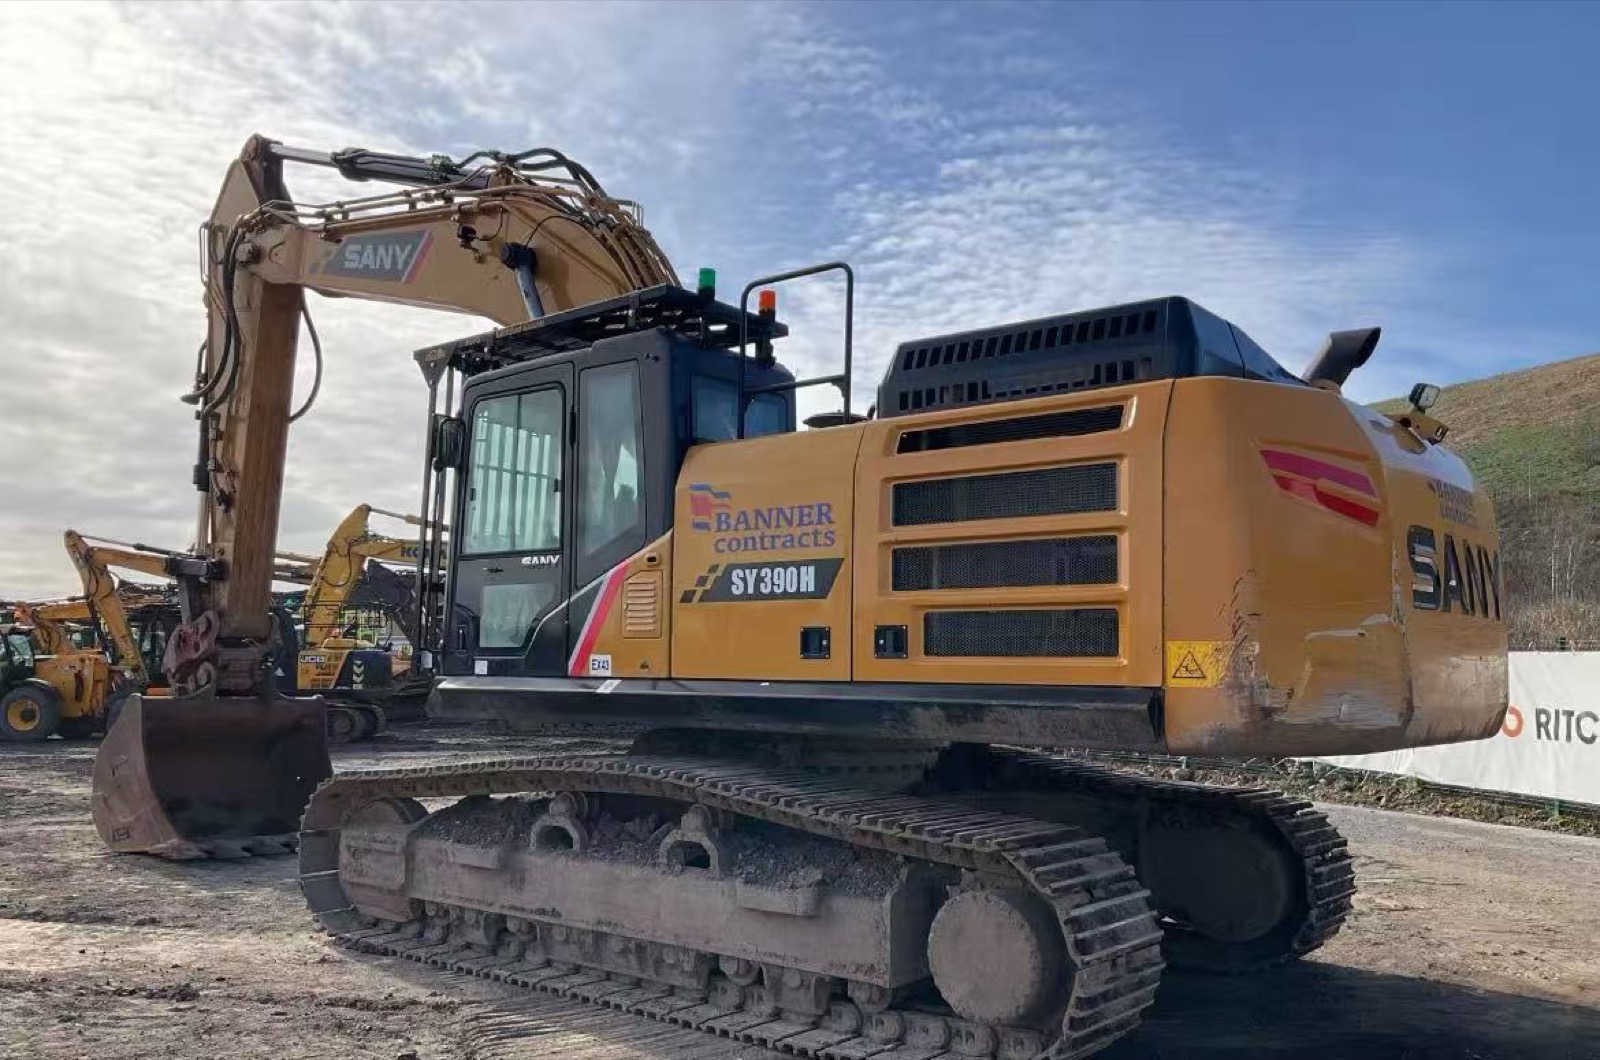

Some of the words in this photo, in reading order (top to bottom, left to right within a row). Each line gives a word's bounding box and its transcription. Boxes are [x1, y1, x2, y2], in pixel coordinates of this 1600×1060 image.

[344, 243, 412, 269] SANY
[715, 502, 835, 532] BANNER
[714, 529, 836, 553] contracts
[731, 565, 815, 595] SY390H
[1535, 707, 1600, 745] RITC
